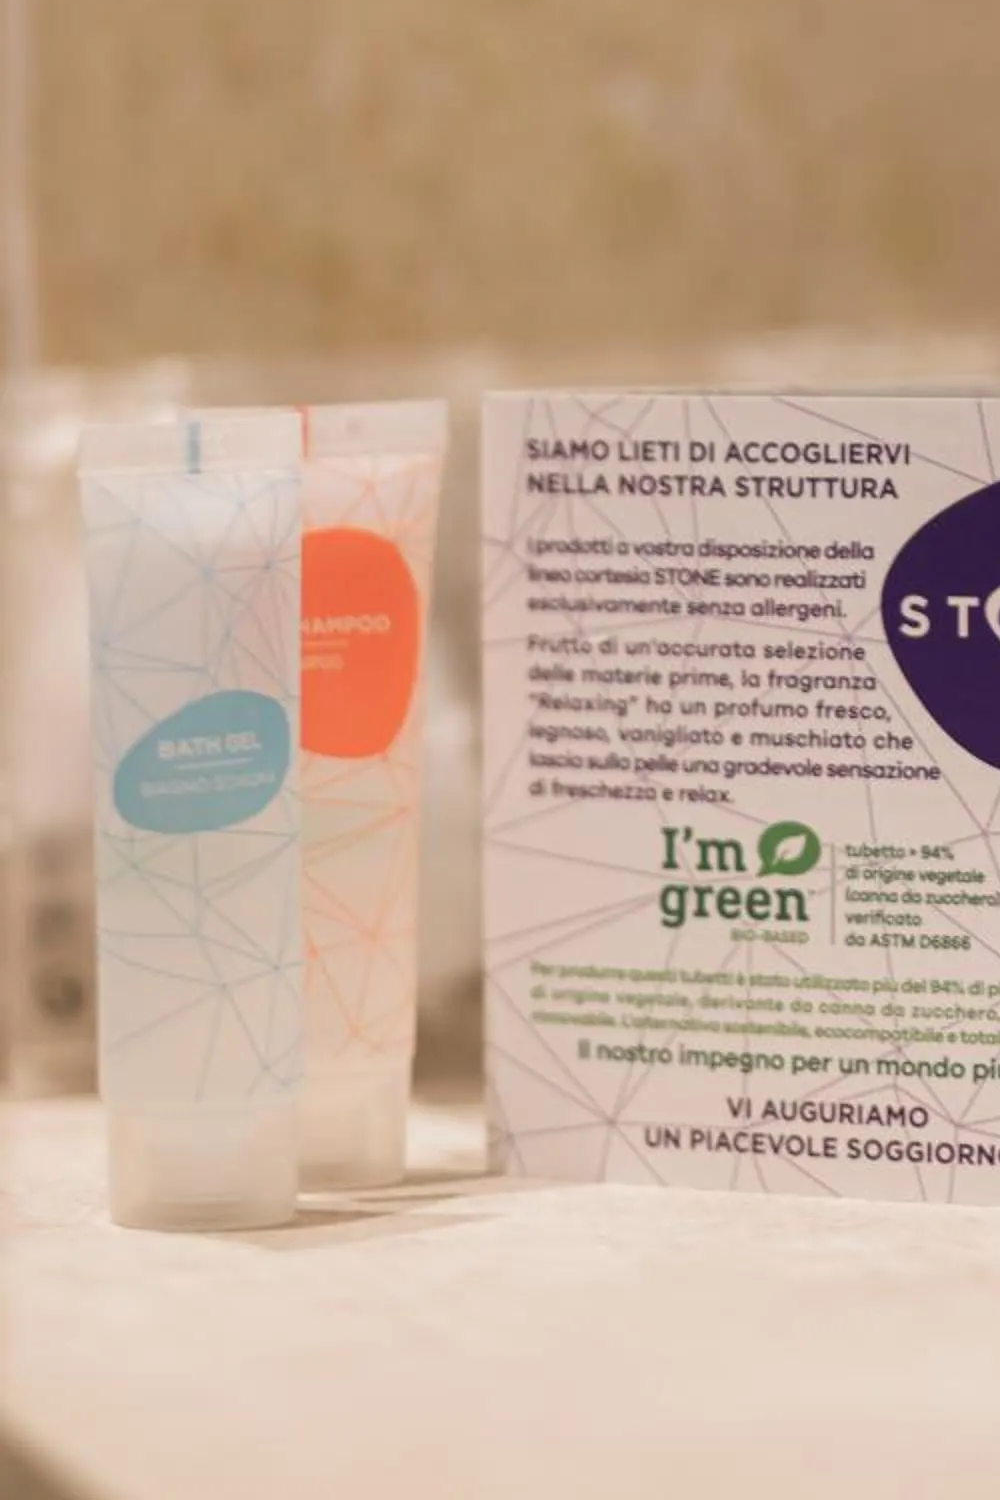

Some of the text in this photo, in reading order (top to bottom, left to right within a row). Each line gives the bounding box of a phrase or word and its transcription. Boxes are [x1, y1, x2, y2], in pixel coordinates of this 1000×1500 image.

[527, 439, 911, 465] SIAMO LIETI DI ACCOGLIERVI
[527, 473, 898, 499] NELLA NOSTRA STRUTTURA
[537, 536, 613, 556] prodotti
[617, 542, 630, 555] a
[633, 539, 694, 556] vostra
[699, 538, 820, 561] disposizione
[824, 540, 874, 560] della
[575, 567, 650, 584] cortesia
[655, 568, 720, 586] STONE
[724, 573, 771, 588] sono
[775, 570, 866, 590] realizzati
[687, 601, 745, 617] senza
[752, 599, 846, 621] allergeni.
[528, 634, 865, 662] Frutto di un'accurata selezione
[528, 663, 877, 693] delle materie prime, la fragranza
[646, 696, 672, 714] ha
[680, 702, 706, 714] un
[715, 700, 807, 722] profumo
[816, 701, 891, 723] fresco,
[158, 736, 222, 760] BATH
[618, 725, 723, 748] vanigliato
[731, 732, 742, 746] e
[751, 729, 866, 749] muschiato
[874, 732, 913, 751] che
[588, 752, 630, 770] sulla
[635, 754, 678, 774] pelle
[683, 759, 719, 775] una
[724, 758, 822, 780] gradevole
[827, 764, 940, 781] sensazione
[529, 778, 734, 804] di freschezza e relax.
[661, 826, 746, 873] I'm
[845, 844, 905, 860] tubetto
[921, 846, 954, 861] 94%
[845, 867, 985, 887] di origine vegetale
[660, 884, 810, 929] green
[845, 888, 899, 905] (canna
[902, 890, 922, 905] da
[845, 911, 922, 928] verificato
[731, 928, 809, 944] BIO-BASED
[845, 934, 865, 948] da
[870, 934, 915, 949] ASTM
[902, 978, 926, 993] del
[931, 978, 964, 994] 94%
[968, 980, 984, 996] di
[790, 1000, 812, 1014] da
[819, 1002, 875, 1016] canna
[880, 1003, 905, 1018] da
[912, 1004, 1000, 1021] zucchero,
[947, 1030, 957, 1042] e
[597, 1042, 672, 1063] nostro
[679, 1043, 784, 1073] impegno
[791, 1053, 832, 1074] per
[839, 1058, 869, 1074] un
[877, 1056, 965, 1079] mondo
[727, 1097, 928, 1128] VI AUGURIAMO
[645, 1127, 680, 1149] UN
[690, 1128, 838, 1158] PIACEVOLE
